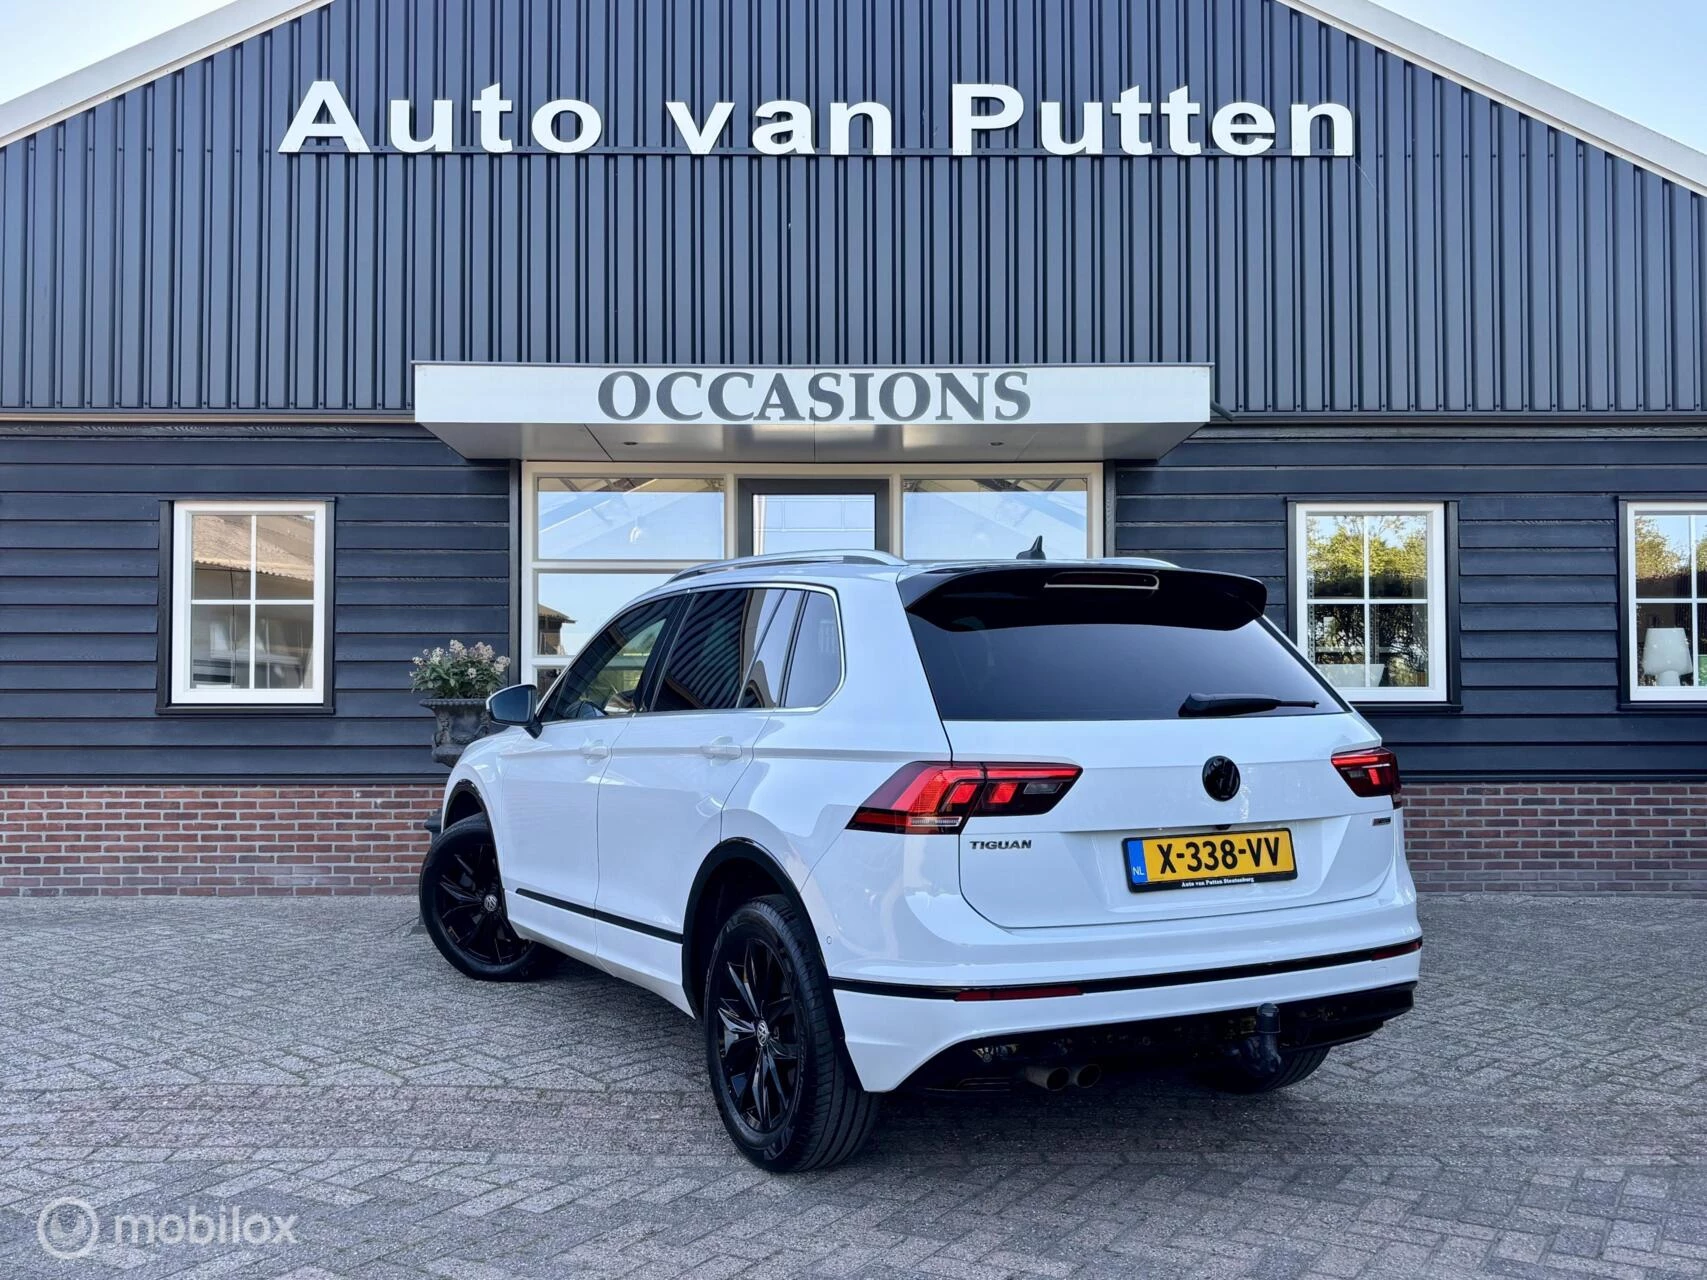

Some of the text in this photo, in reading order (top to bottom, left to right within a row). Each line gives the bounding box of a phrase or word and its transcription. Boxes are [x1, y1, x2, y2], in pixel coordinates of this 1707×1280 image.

[278, 80, 1354, 158] Auto van Putten
[598, 370, 1031, 423] OCCASIONS
[969, 839, 1032, 850] TIGUAN
[1157, 837, 1280, 875] X-338-VV
[1132, 865, 1145, 877] NL
[1181, 880, 1195, 888] Auto
